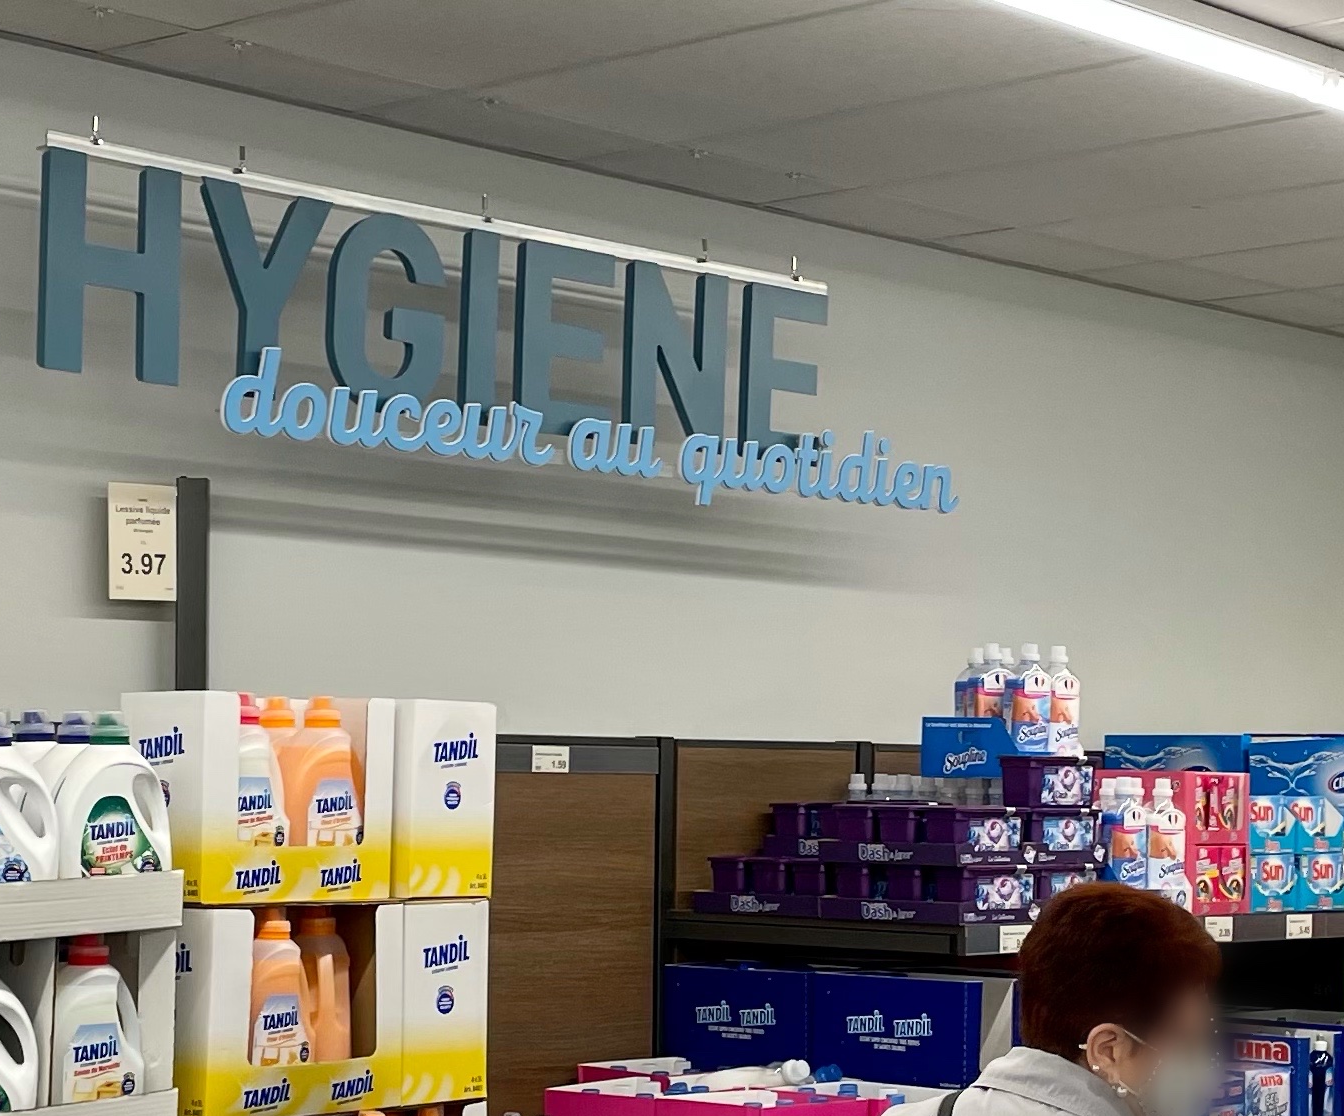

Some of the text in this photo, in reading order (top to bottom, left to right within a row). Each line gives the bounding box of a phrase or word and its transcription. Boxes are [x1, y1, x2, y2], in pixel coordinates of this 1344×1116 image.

[36, 147, 829, 449] HYGIENE
[221, 346, 960, 515] douceur au quotidien
[121, 552, 167, 576] 3.97
[138, 726, 185, 760] TANDIL
[433, 732, 479, 763] TANDIL
[238, 788, 273, 813] TANDIL
[315, 789, 354, 814] TANDIL
[1250, 802, 1275, 823] Sun
[1291, 802, 1315, 822] Sun
[89, 813, 136, 841] TANDIL
[798, 838, 819, 856] Das
[857, 843, 890, 862] Dash
[235, 859, 281, 890] TANDIL
[319, 858, 362, 889] TANDIL
[1261, 859, 1286, 882] Sun
[1310, 859, 1336, 881] Sun
[730, 894, 759, 912] Dash
[860, 901, 893, 920] Dash
[422, 934, 470, 969] TANDIL
[262, 1005, 299, 1031] TANDIL
[696, 1000, 776, 1026] TANDIL TANDIL
[846, 1010, 932, 1037] TANDIL TANDIL
[72, 1035, 120, 1063] TANDIL
[330, 1069, 375, 1102] TANDIL
[1260, 1073, 1284, 1087] una
[243, 1077, 291, 1110] TANDIL
